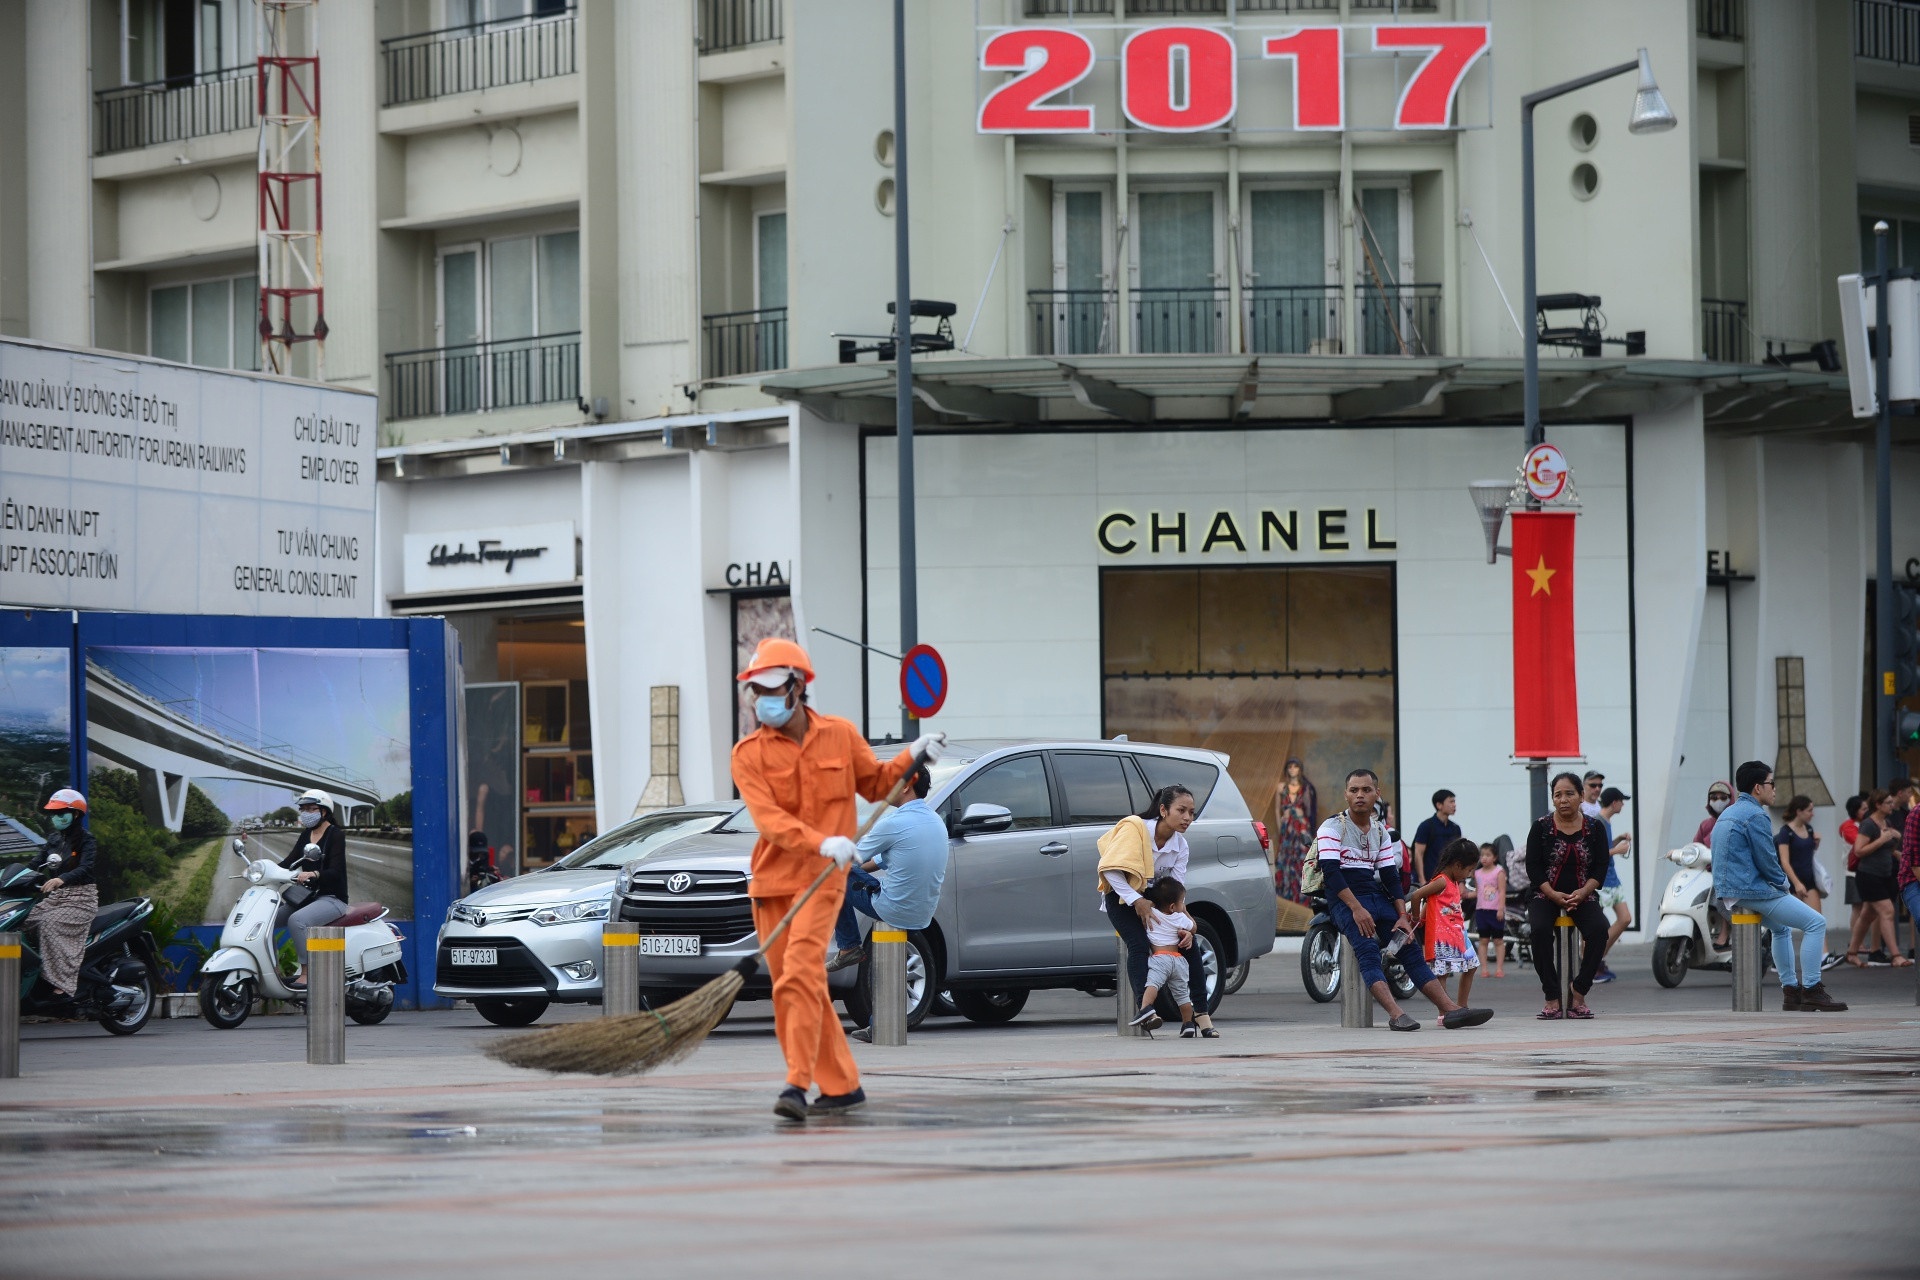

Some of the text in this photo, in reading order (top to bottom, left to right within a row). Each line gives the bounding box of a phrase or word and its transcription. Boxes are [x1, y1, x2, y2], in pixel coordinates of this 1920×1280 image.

[977, 22, 1492, 134] 2017
[22, 378, 54, 409] QUẢN
[57, 381, 72, 411] LÝ
[74, 384, 117, 416] ĐƯỜNG
[143, 393, 158, 423] ĐÔ
[161, 401, 178, 431] THỊ
[294, 412, 317, 442] CHỦ
[345, 422, 360, 447] TƯ
[75, 428, 137, 460] AUTHORITY
[138, 437, 160, 463] FOR
[161, 440, 195, 469] URBAN
[198, 445, 246, 474] RAILWAYS
[301, 455, 359, 485] EMPLOYER
[0, 497, 100, 537] IÊN DANH NJPT
[1098, 508, 1397, 555] CHANEL
[29, 546, 118, 579] ASSOCIATION
[277, 530, 293, 555] TƯ
[320, 534, 358, 561] CHUNG
[234, 565, 357, 599] GENERAL CONSULTANT
[725, 560, 791, 587] CHA
[452, 949, 496, 964] 51F-973.31
[641, 938, 699, 953] 51G-219.49
